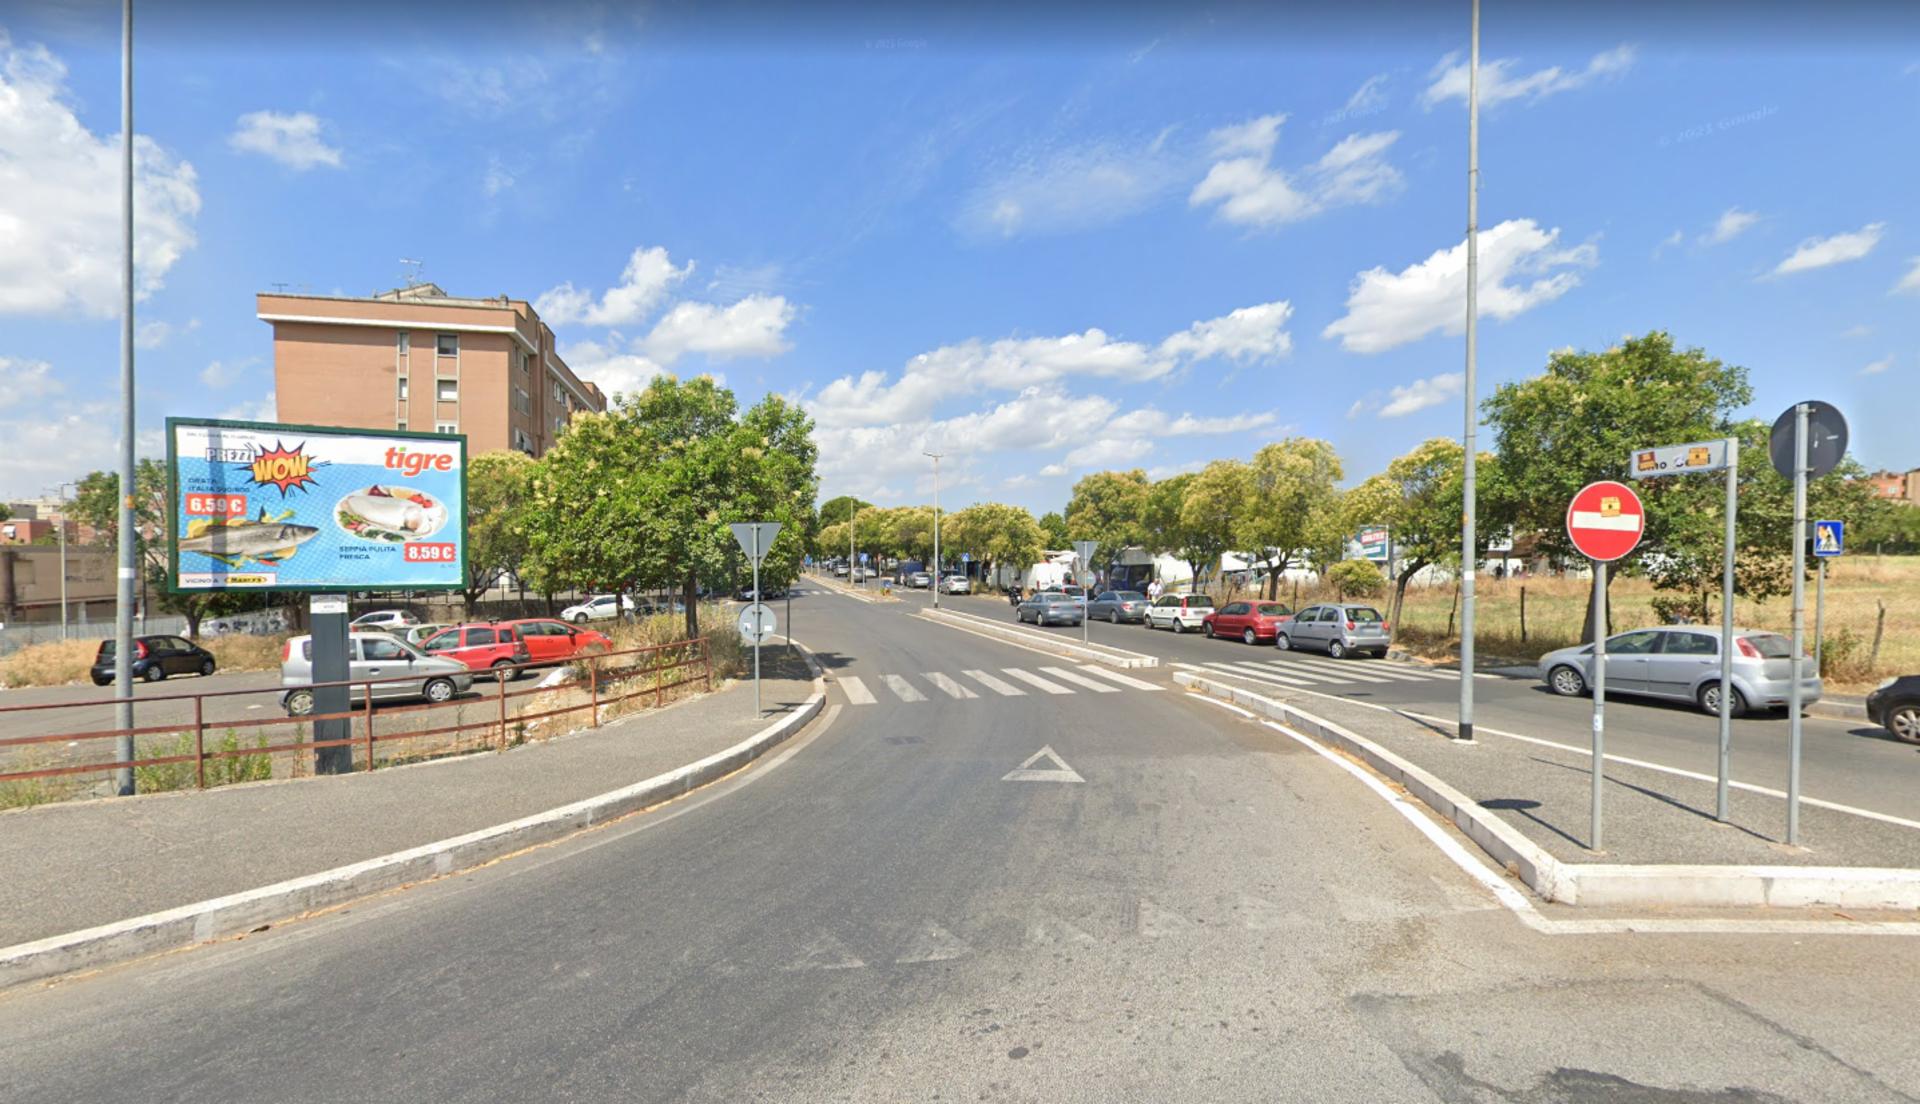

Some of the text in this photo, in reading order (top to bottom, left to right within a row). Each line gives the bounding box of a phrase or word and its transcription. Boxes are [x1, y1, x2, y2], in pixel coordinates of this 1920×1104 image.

[206, 448, 257, 463] PREZZI
[385, 446, 453, 477] tigre
[253, 456, 308, 482] WOW
[230, 498, 243, 513] €
[442, 546, 453, 559] €
